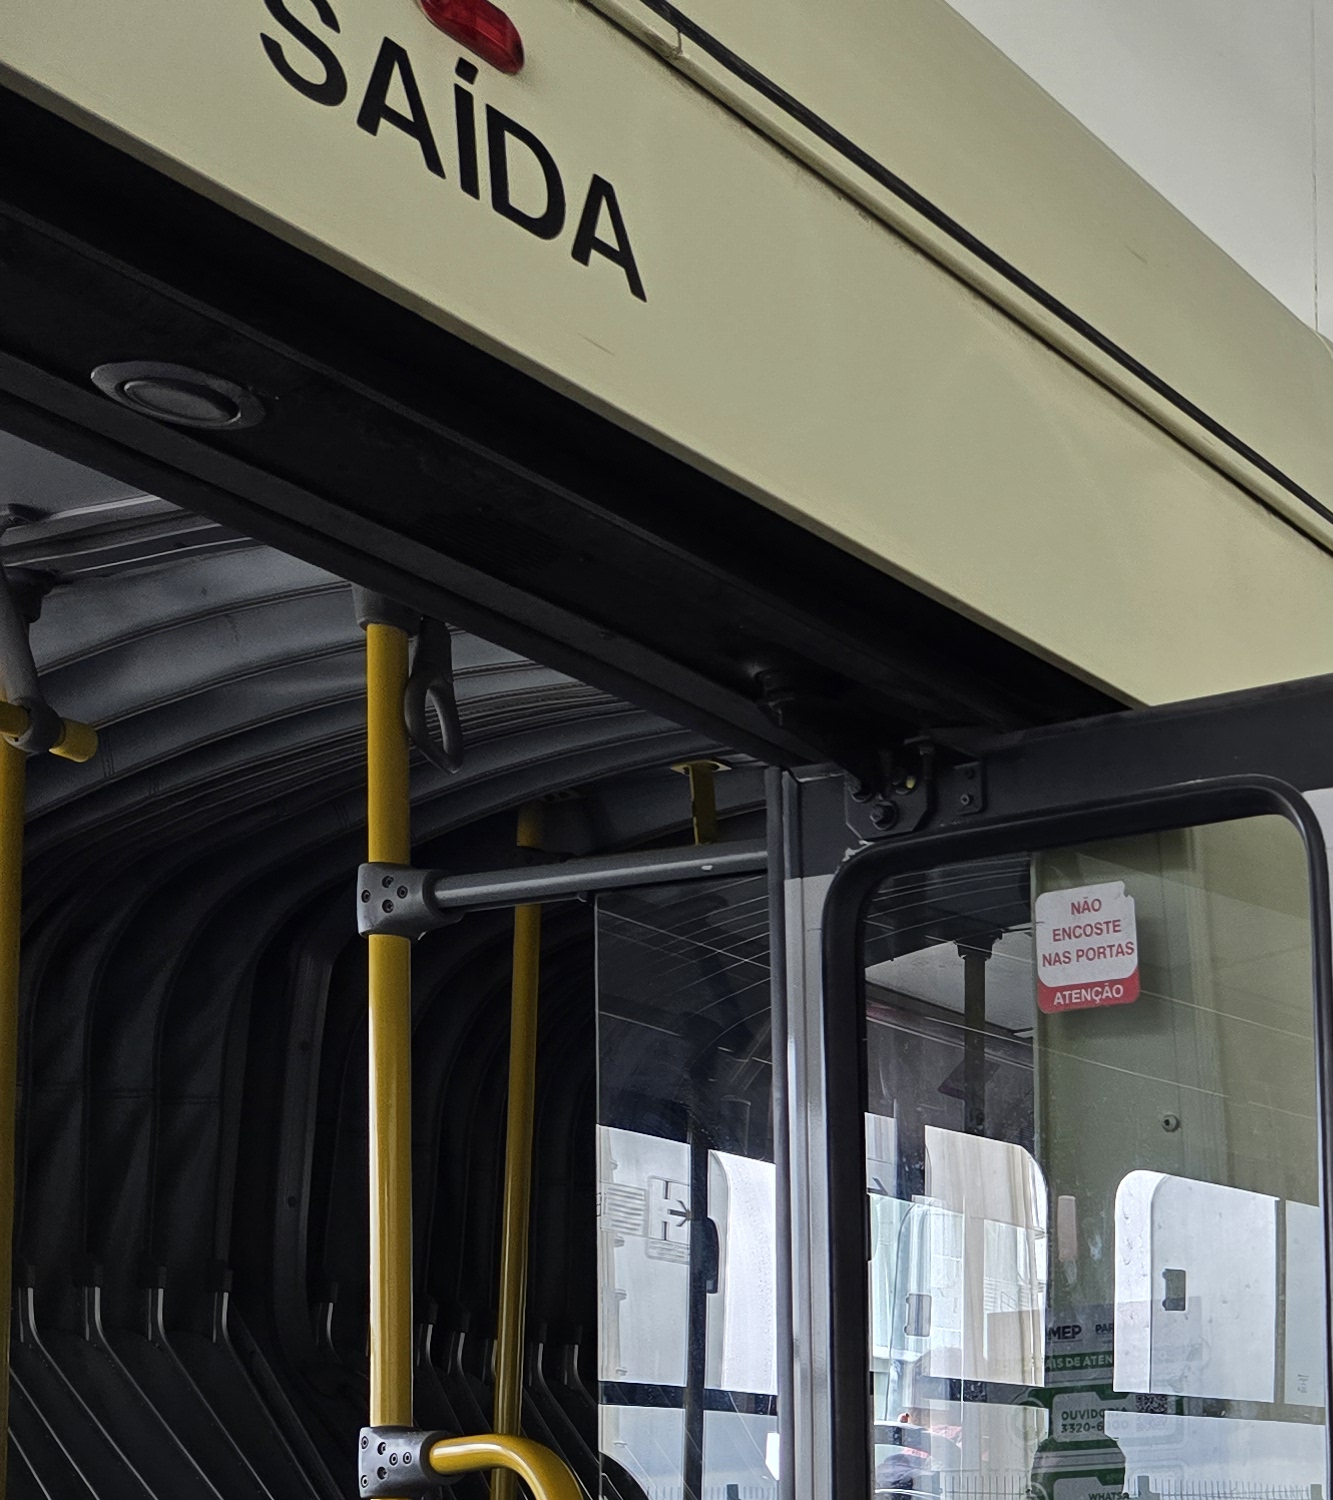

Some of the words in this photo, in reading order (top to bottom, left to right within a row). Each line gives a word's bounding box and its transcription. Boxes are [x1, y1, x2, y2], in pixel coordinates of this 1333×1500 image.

[260, 0, 648, 303] SAÍDA
[1070, 896, 1102, 916] NÃO
[1052, 919, 1122, 942] ENCOSTE
[1042, 951, 1072, 968] NAS
[1076, 941, 1135, 963] PORTAS
[1053, 983, 1124, 1005] ATENÇÃO
[1066, 1356, 1081, 1367] DE
